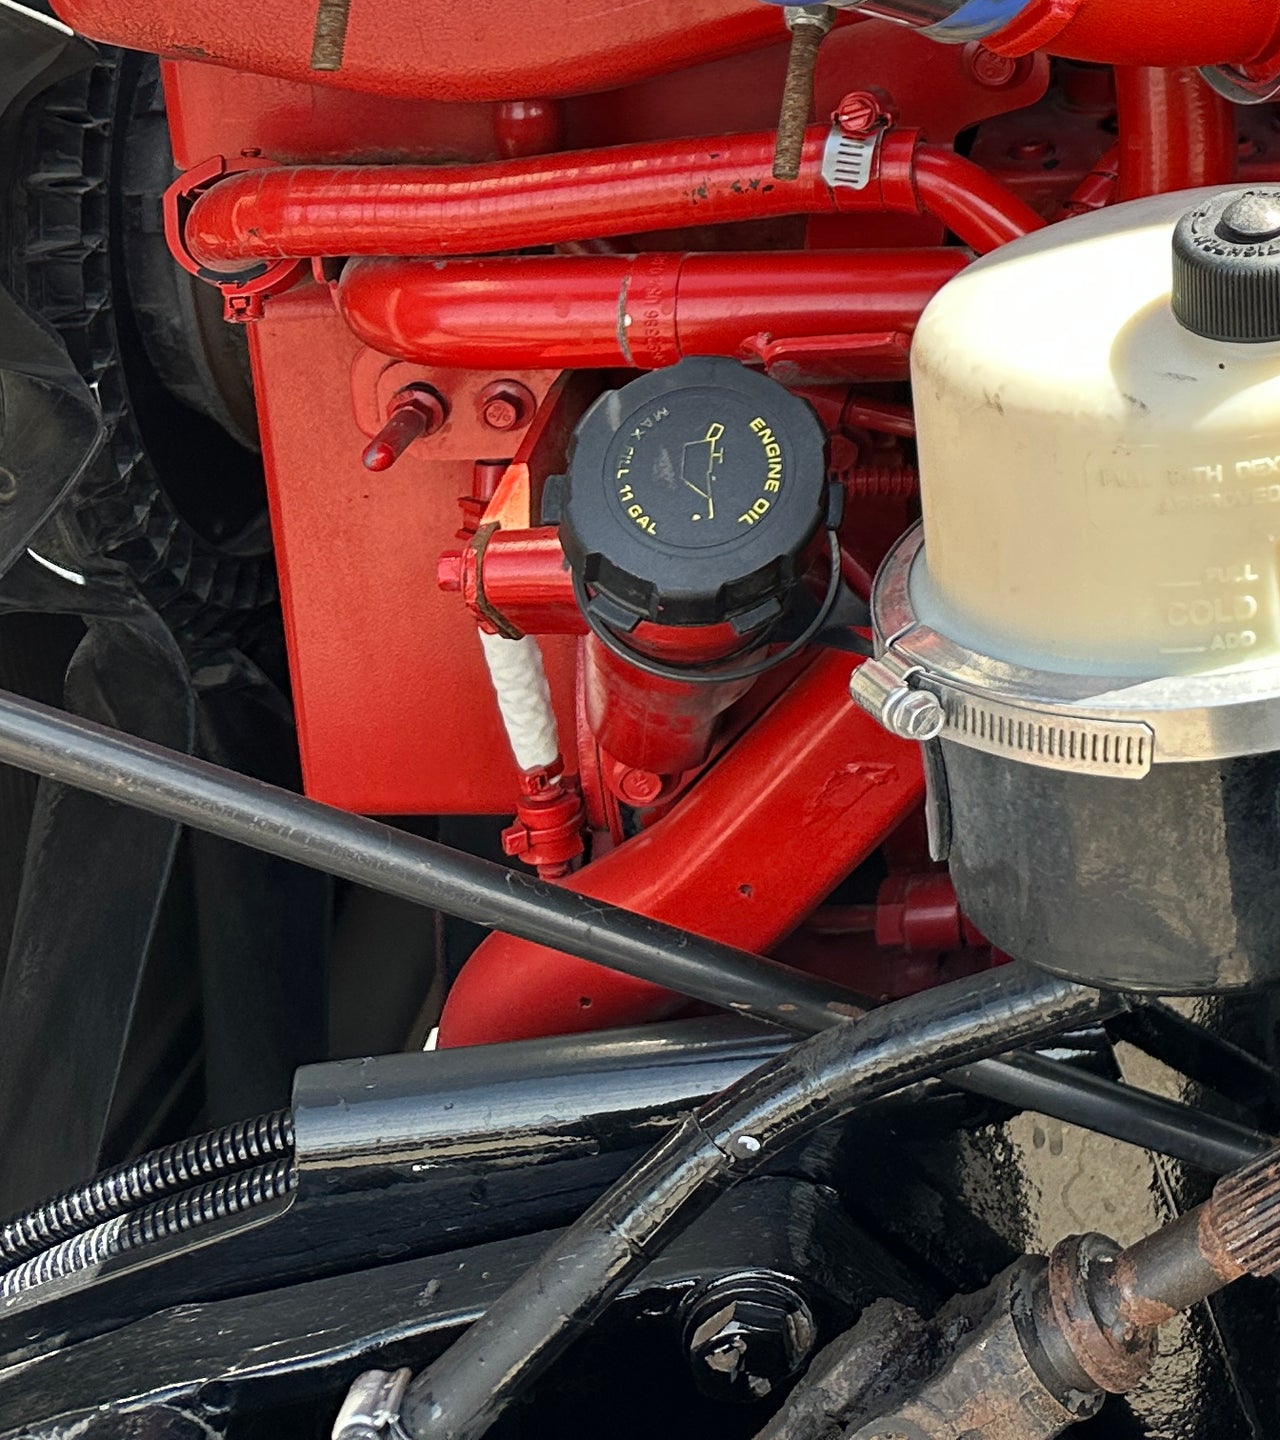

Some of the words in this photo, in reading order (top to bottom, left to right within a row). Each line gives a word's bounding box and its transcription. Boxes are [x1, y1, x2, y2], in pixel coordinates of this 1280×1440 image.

[631, 407, 670, 441] MAX
[616, 446, 635, 480] FILL
[749, 416, 784, 494] ENGINE
[619, 484, 634, 503] 11
[627, 504, 658, 536] GAL
[738, 497, 771, 526] OIL
[1166, 594, 1259, 627] COLD
[1210, 629, 1258, 652] ADD
